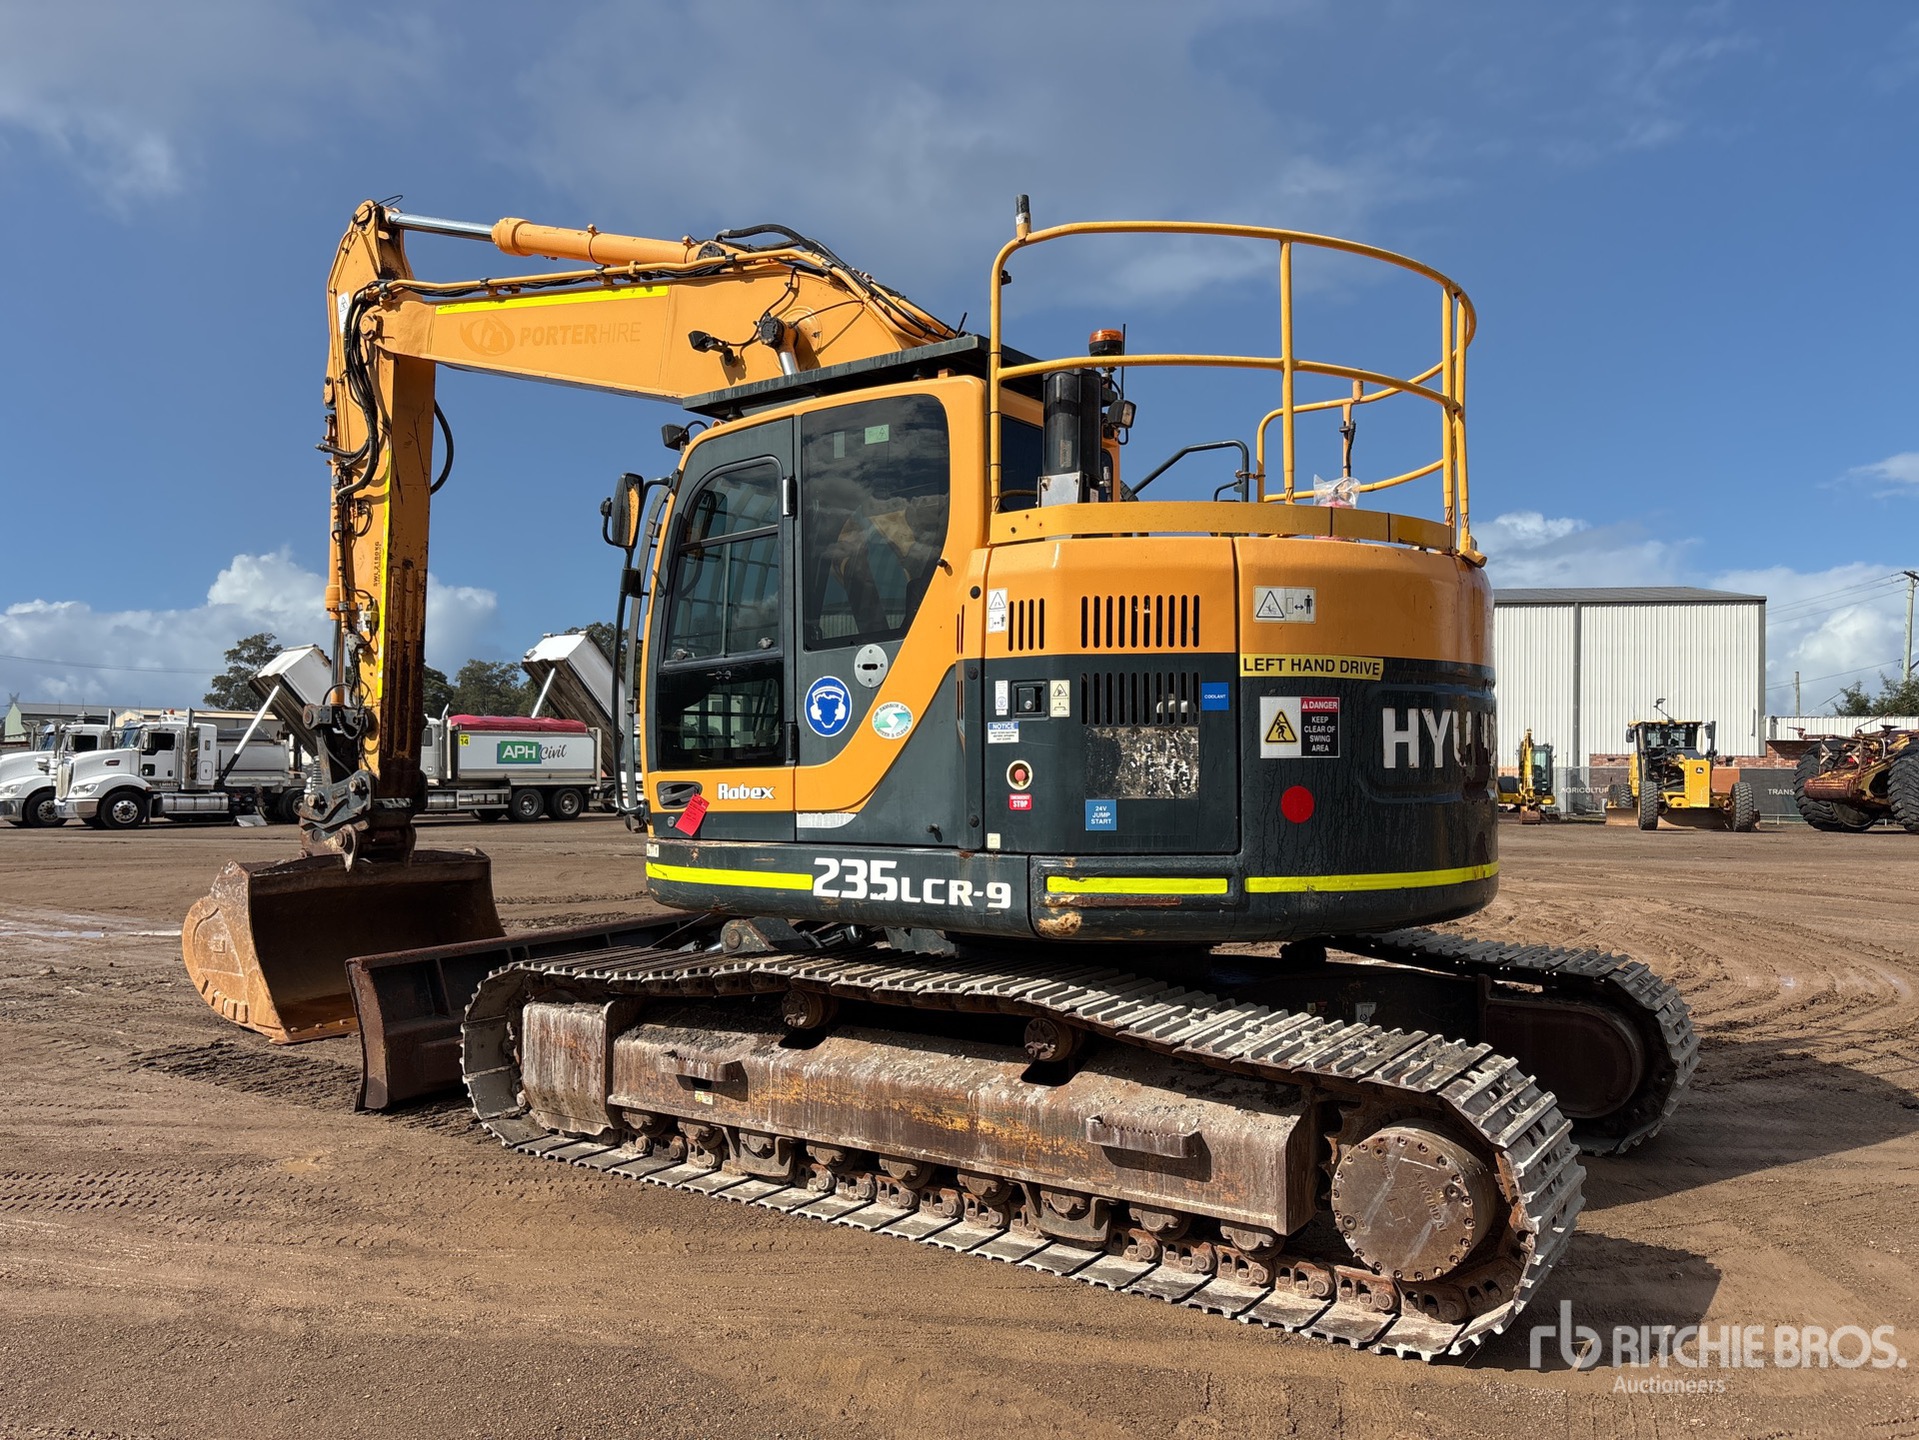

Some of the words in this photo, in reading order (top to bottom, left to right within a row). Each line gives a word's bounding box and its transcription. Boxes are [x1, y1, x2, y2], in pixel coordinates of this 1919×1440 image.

[1243, 658, 1286, 672] LEFT
[1291, 659, 1335, 673] HAND
[1340, 660, 1380, 676] DRIVE
[1309, 701, 1338, 709] DANGER
[1304, 725, 1326, 733] CLEAR
[1327, 725, 1336, 733] OF
[1309, 735, 1331, 743] SWING
[502, 745, 536, 759] APH
[540, 744, 567, 760] Civil
[1311, 744, 1330, 752] AREA
[717, 783, 776, 800] Robex
[1768, 788, 1795, 796] TRANS
[1013, 800, 1028, 808] STOP
